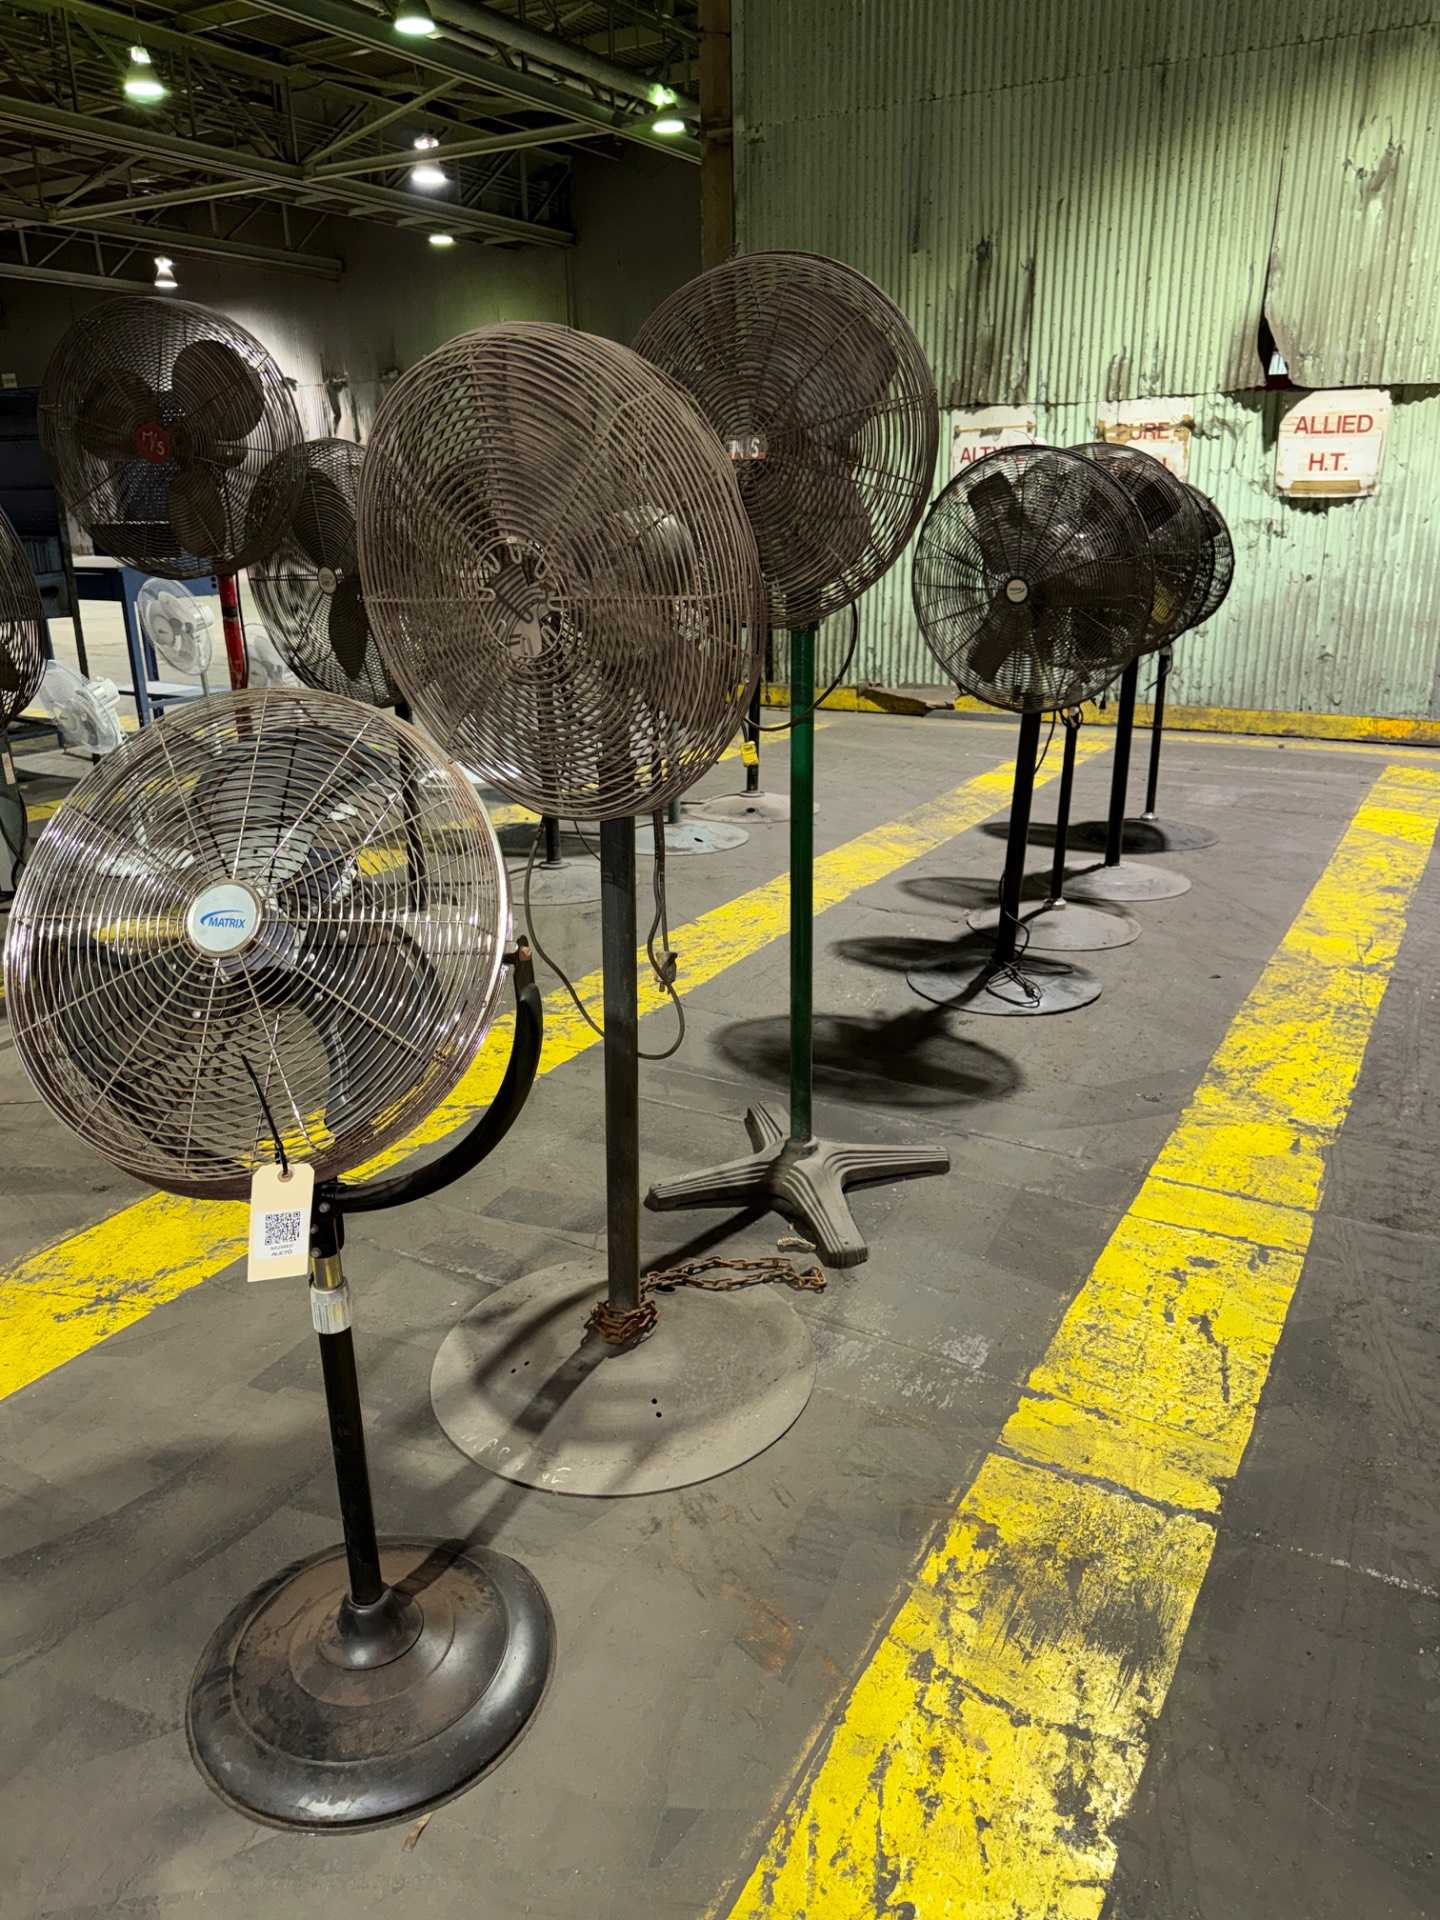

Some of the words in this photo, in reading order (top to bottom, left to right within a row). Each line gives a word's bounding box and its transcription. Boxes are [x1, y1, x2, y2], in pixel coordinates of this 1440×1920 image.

[1294, 414, 1374, 434] ALLIED
[1308, 452, 1348, 471] H.T.
[208, 917, 246, 929] MATRIX
